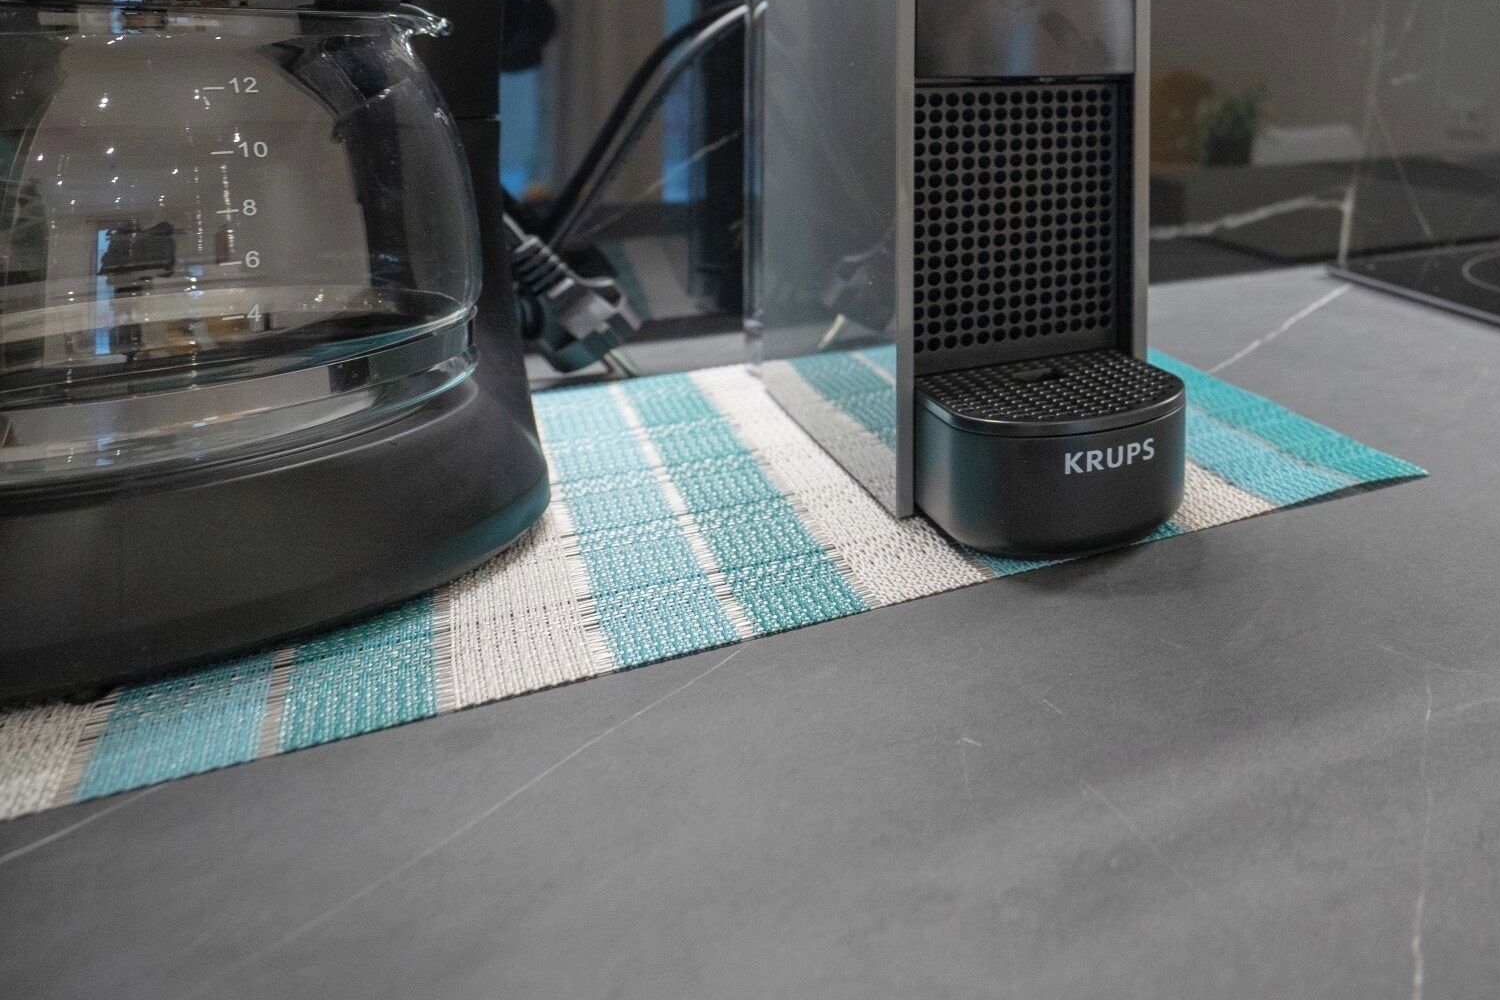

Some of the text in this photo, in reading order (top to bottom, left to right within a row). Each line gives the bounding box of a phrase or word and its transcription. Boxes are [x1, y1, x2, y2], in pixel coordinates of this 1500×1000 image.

[229, 77, 259, 93] 12
[238, 141, 268, 158] 10
[242, 199, 257, 216] 8
[245, 250, 260, 268] 6
[246, 303, 263, 322] 4
[1064, 437, 1155, 475] KRUPS
